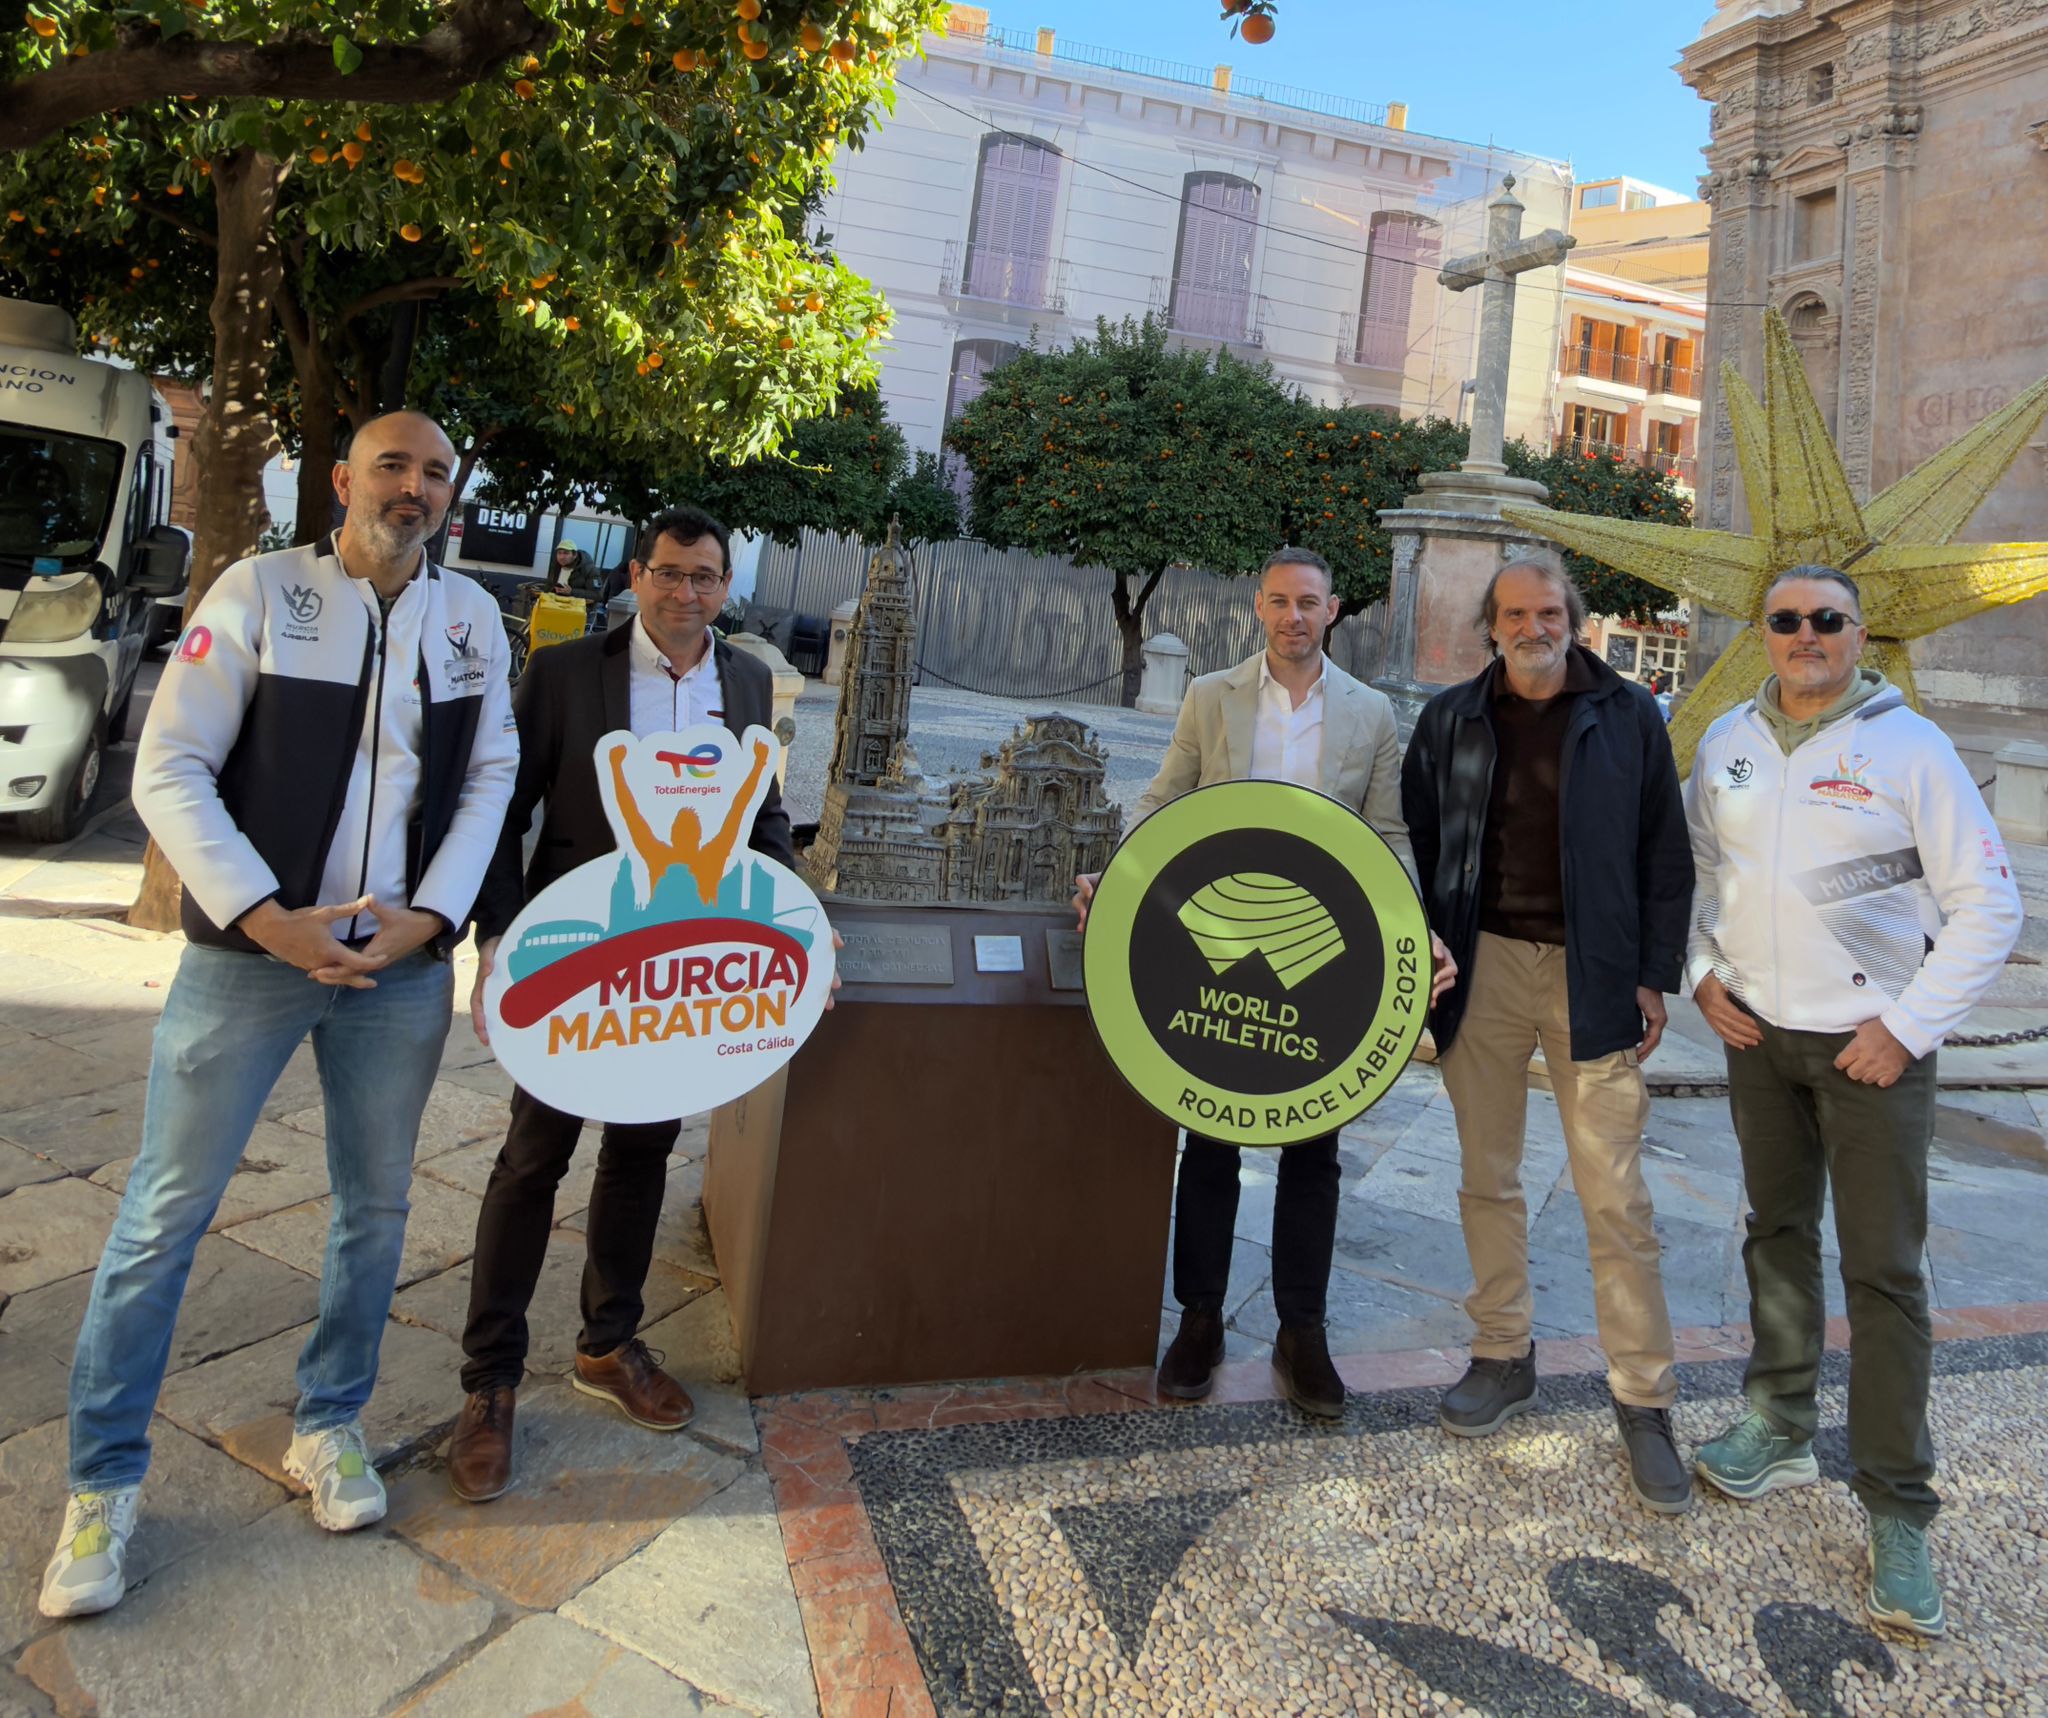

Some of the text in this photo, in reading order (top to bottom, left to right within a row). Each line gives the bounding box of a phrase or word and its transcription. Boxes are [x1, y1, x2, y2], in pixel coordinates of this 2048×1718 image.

[0, 379, 44, 393] NO
[477, 507, 527, 530] DEMO
[654, 784, 722, 796] TotalEnergies
[1818, 862, 1906, 897] MURCIA
[598, 949, 797, 1007] MURCIA
[547, 985, 788, 1056] MARATÓN
[1199, 986, 1300, 1028] WORLD
[717, 1035, 796, 1057] Costa Cálida
[1167, 1008, 1319, 1062] ATHLETICS
[1177, 935, 1417, 1130] ROAD RACE LABEL 2026
